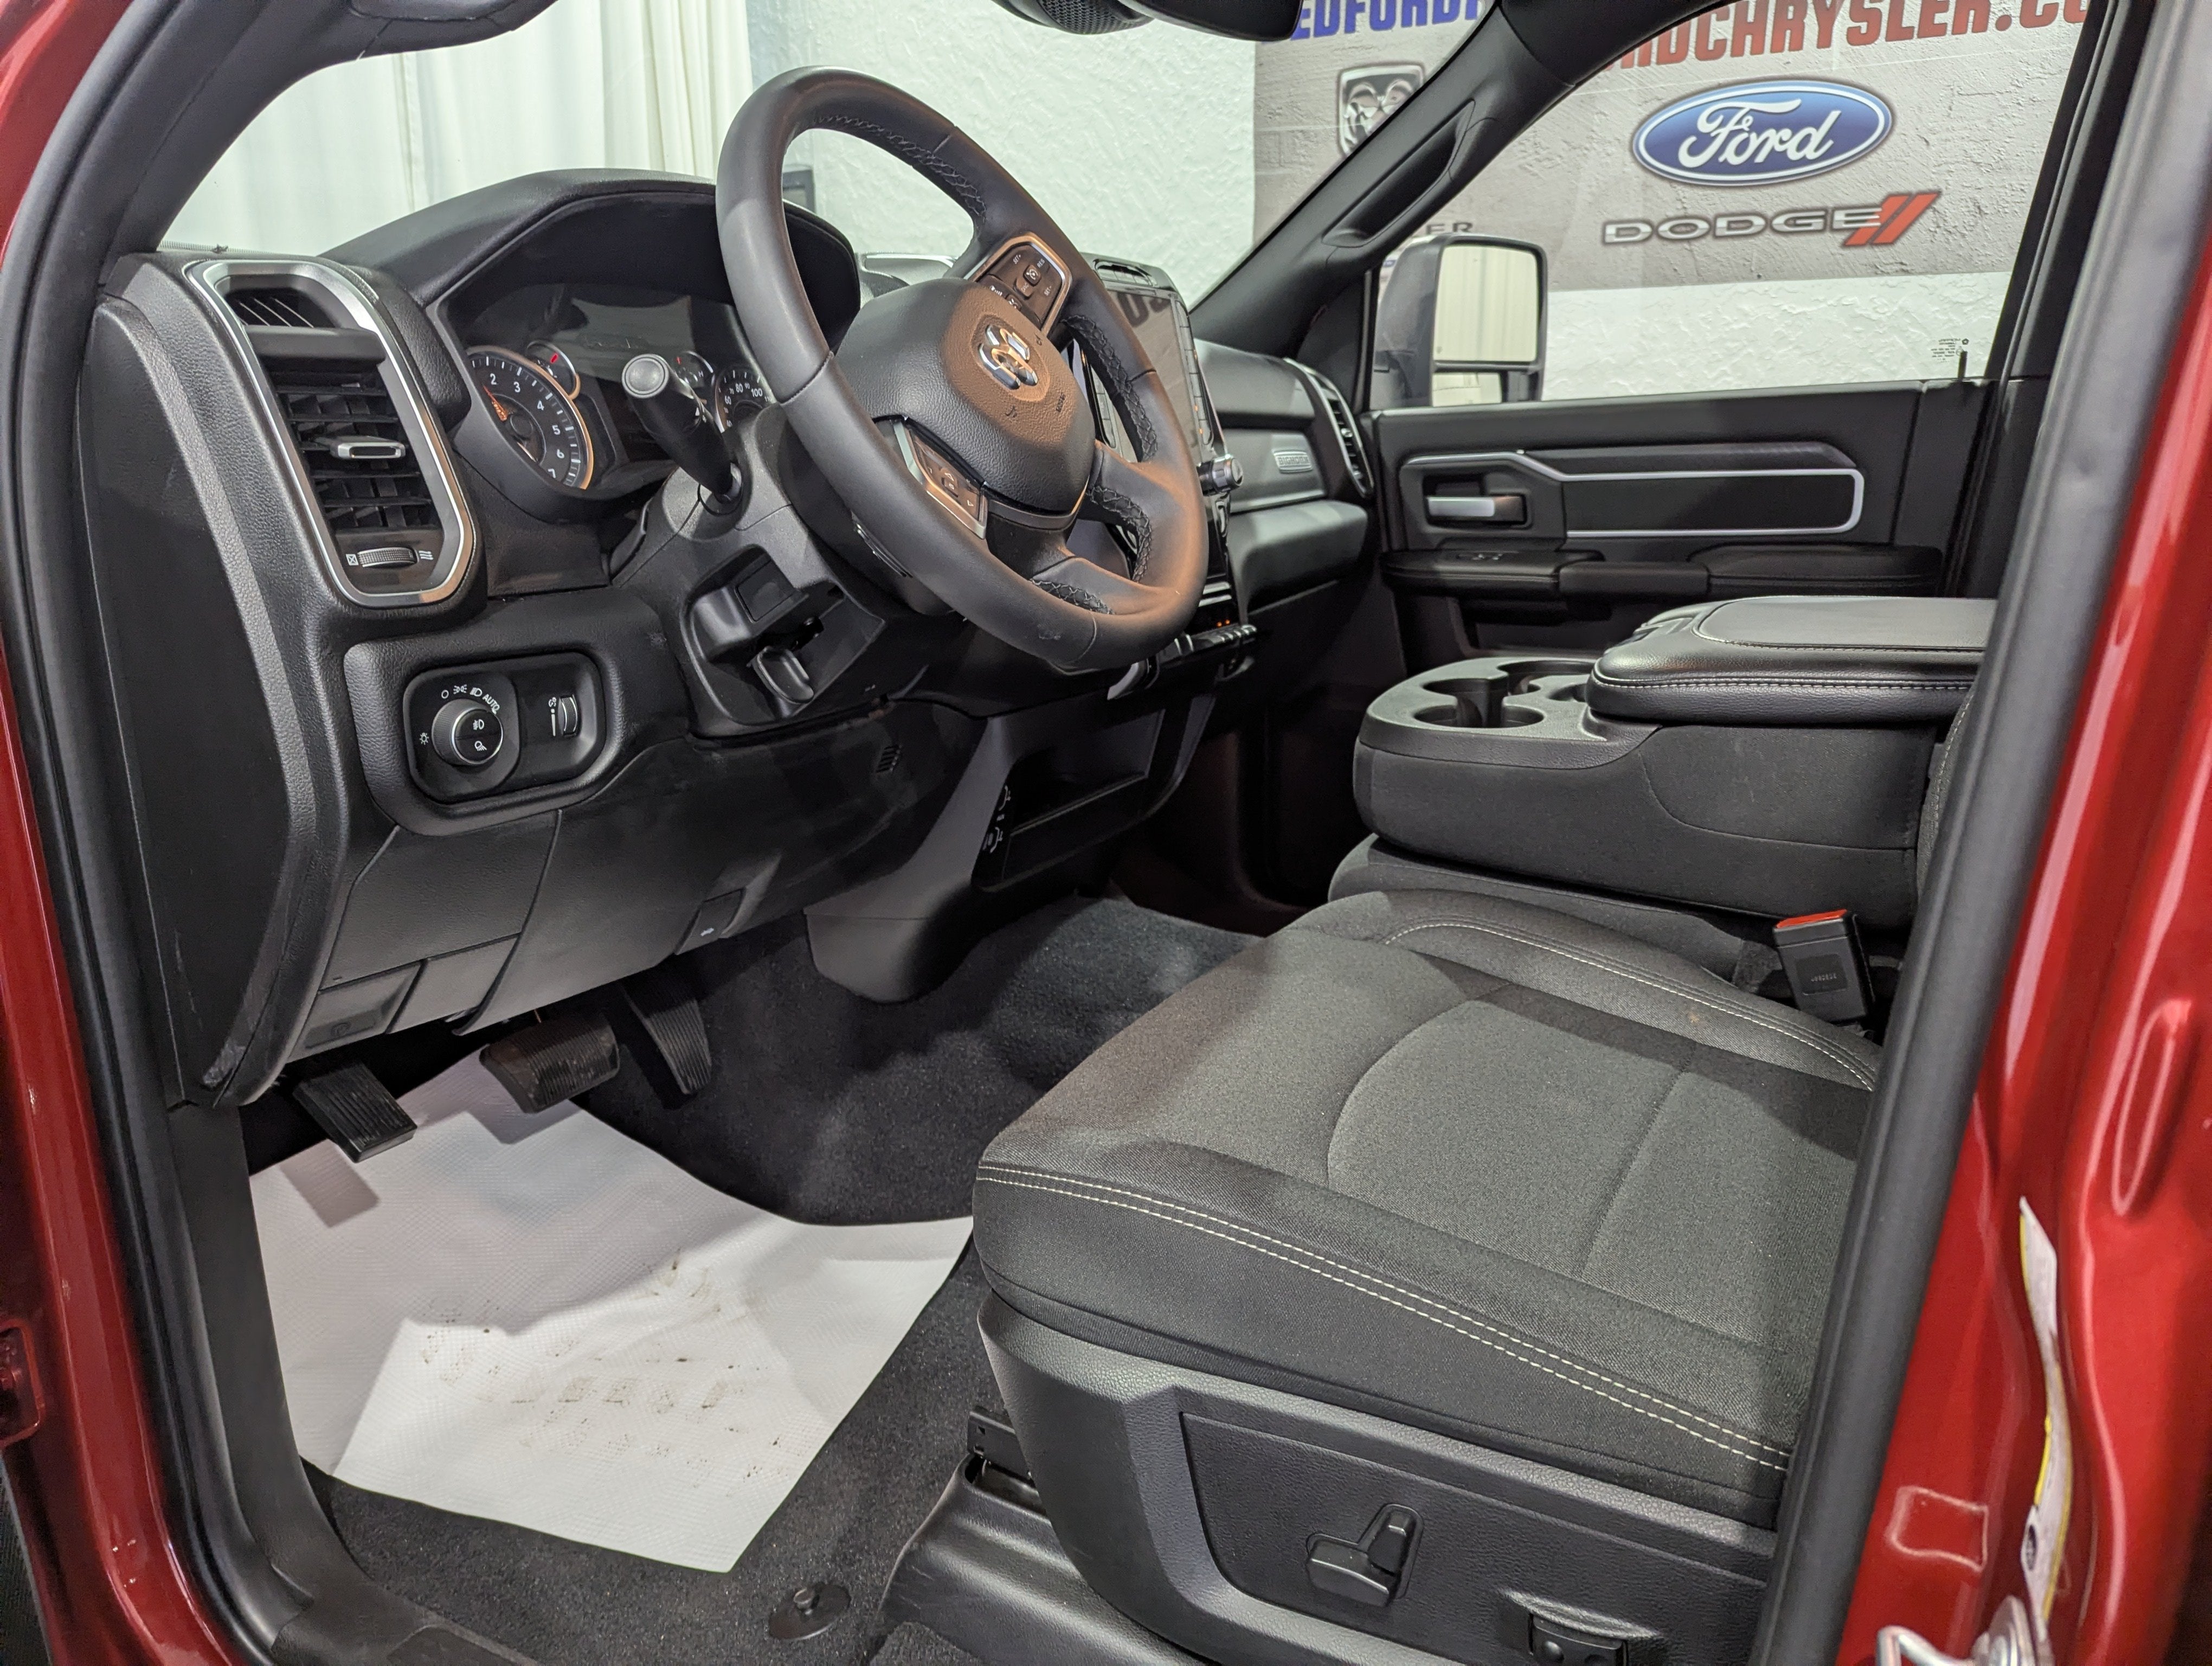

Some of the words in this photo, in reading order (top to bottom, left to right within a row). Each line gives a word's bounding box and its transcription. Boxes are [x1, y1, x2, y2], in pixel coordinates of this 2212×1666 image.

[1677, 98, 1842, 169] Ford
[1603, 206, 1883, 245] DODGE
[490, 373, 497, 385] 2
[513, 381, 520, 393] 3
[736, 383, 743, 393] 80
[751, 388, 763, 397] 100
[724, 395, 731, 405] 60
[537, 400, 544, 411] 4
[552, 425, 561, 435] 5
[557, 449, 565, 459] 6
[548, 469, 556, 478] 7
[483, 694, 500, 712] AUTO
